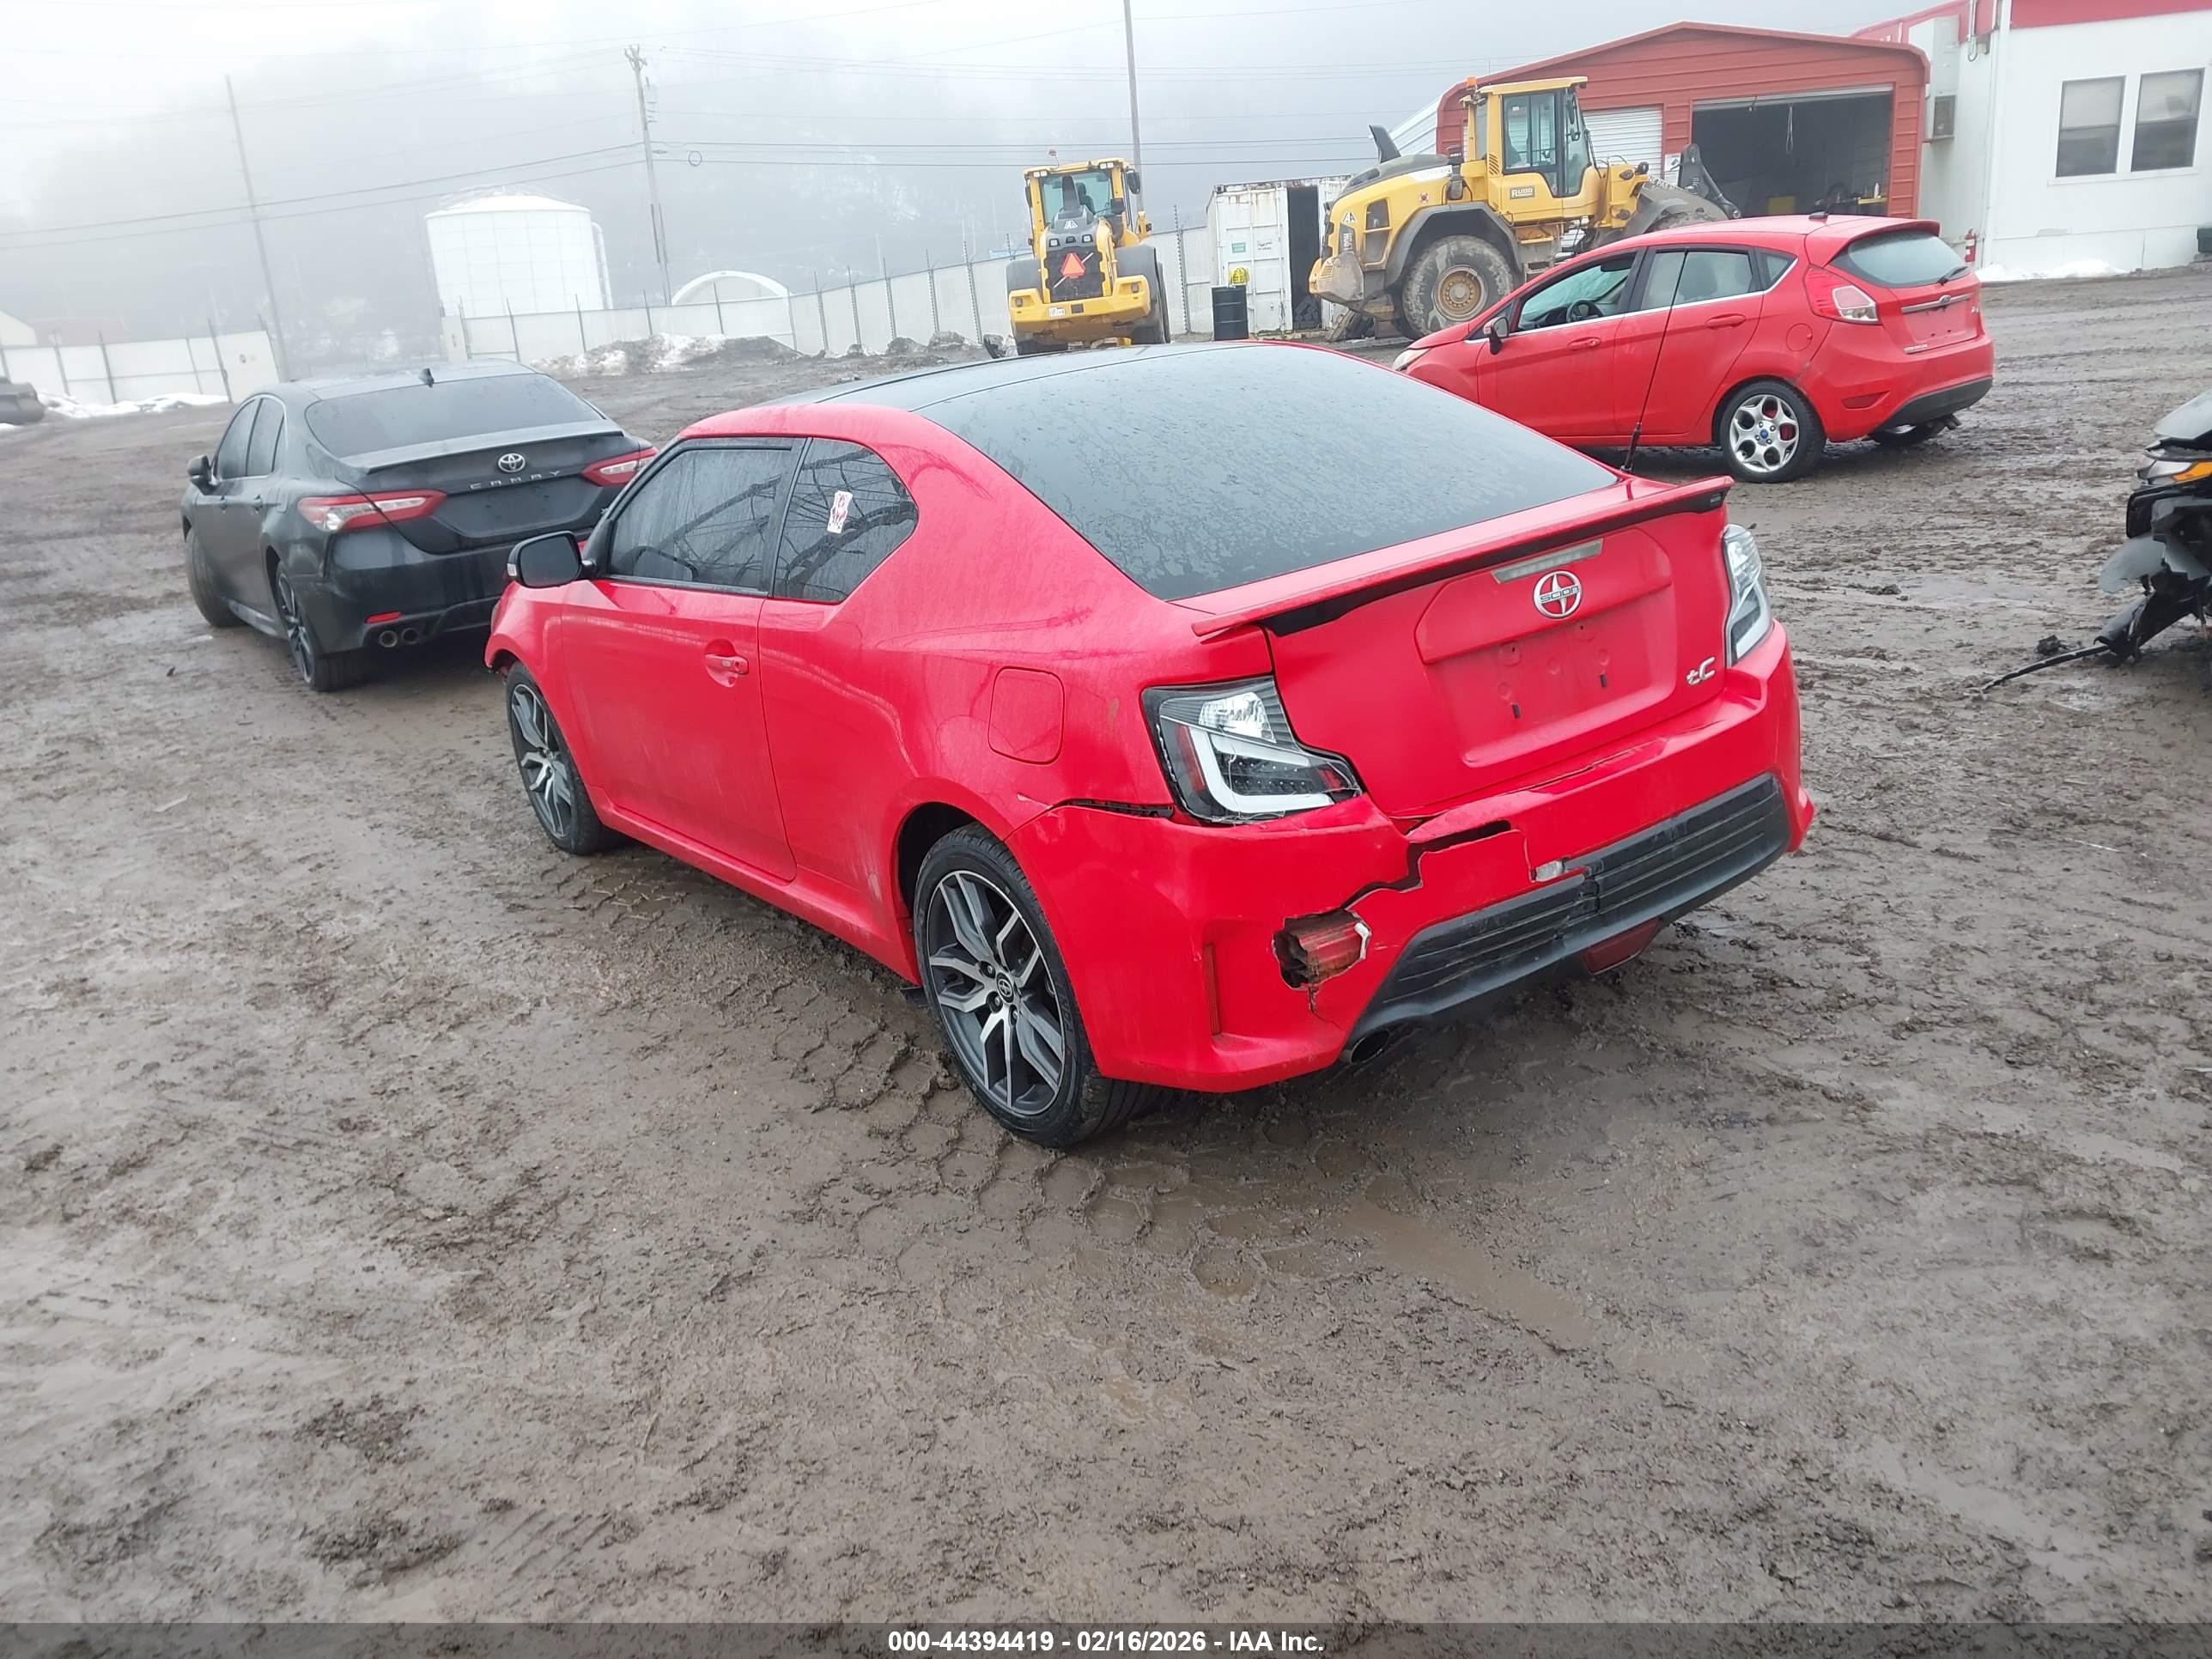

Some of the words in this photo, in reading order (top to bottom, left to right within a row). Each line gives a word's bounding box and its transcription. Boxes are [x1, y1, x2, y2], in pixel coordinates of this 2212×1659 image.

[470, 471, 560, 490] CAMRY
[1540, 585, 1579, 601] SCION
[1686, 656, 1716, 685] tC
